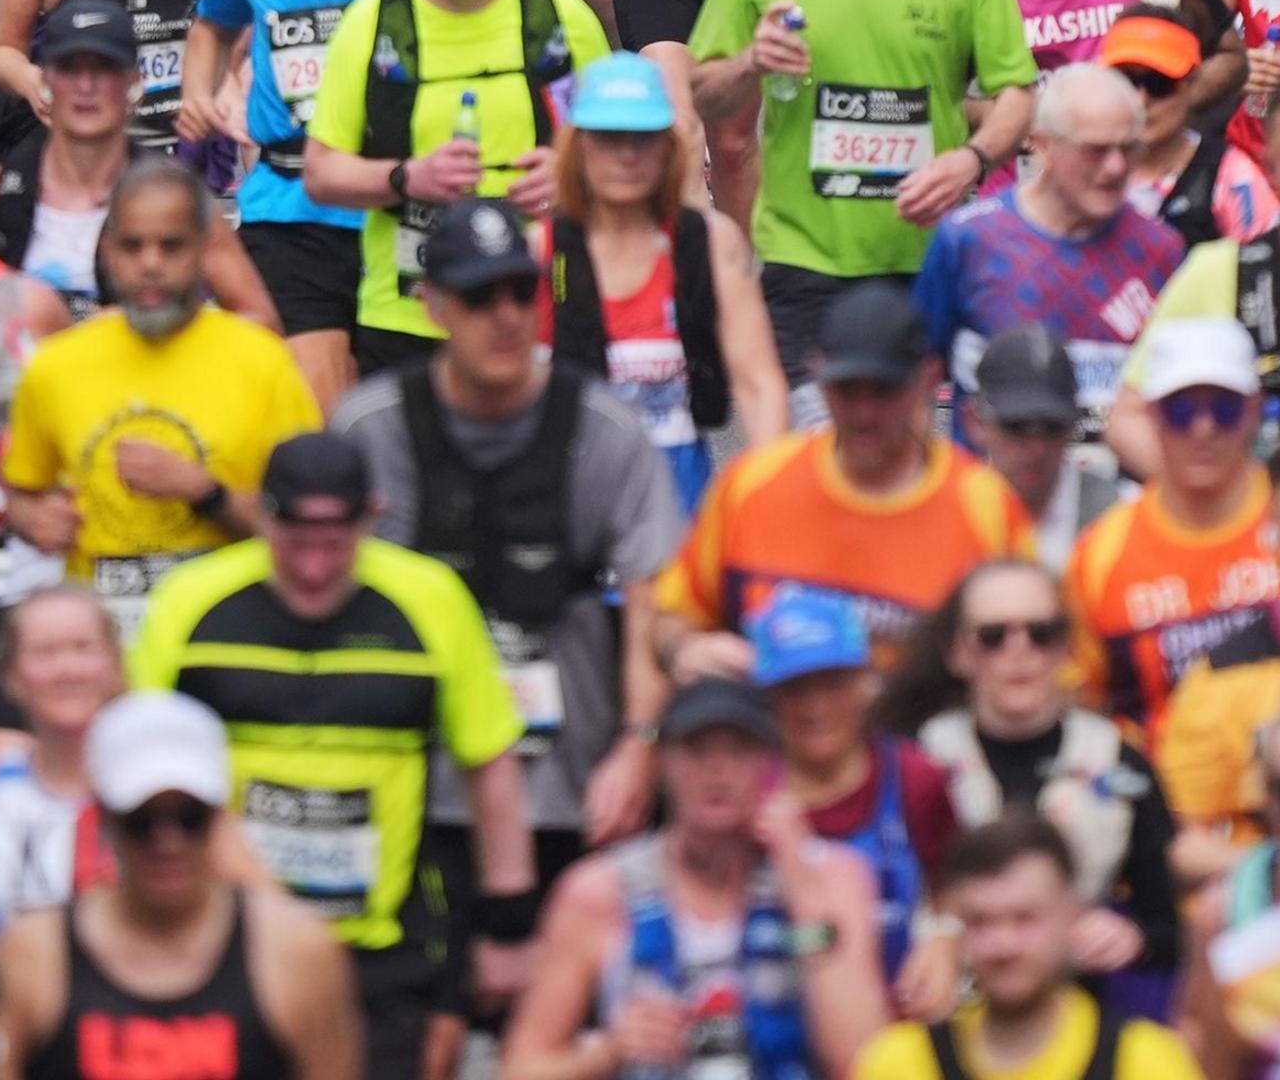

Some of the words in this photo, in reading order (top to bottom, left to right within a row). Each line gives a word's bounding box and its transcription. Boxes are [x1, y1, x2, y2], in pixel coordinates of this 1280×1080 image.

[266, 11, 316, 48] tcs
[820, 87, 867, 119] tcs
[833, 135, 917, 164] 36277
